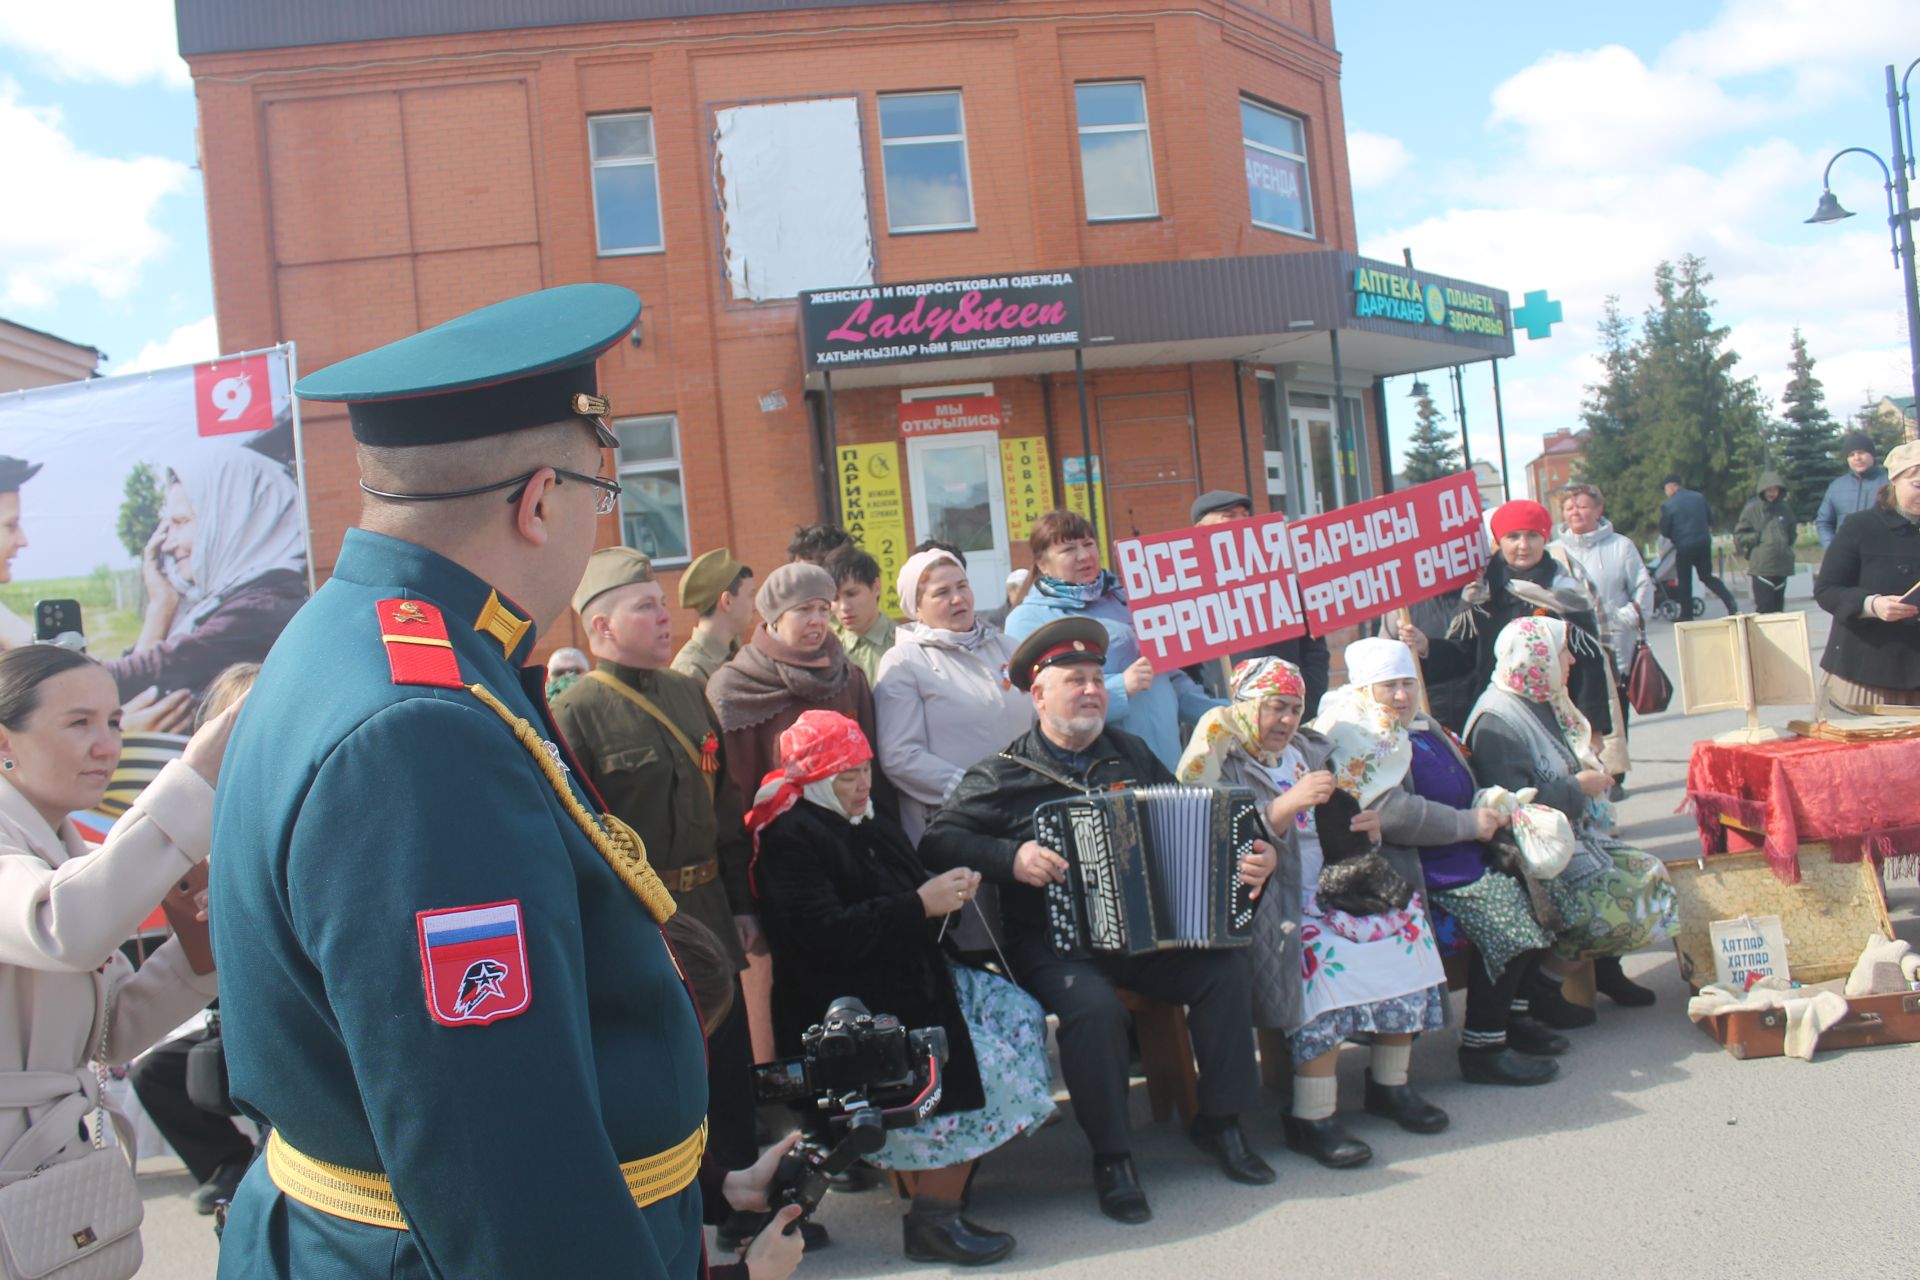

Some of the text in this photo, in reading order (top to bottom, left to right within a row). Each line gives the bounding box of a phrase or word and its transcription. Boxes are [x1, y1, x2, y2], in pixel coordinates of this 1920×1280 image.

[1246, 158, 1298, 198] АРЕНДА
[810, 273, 1073, 304] ЖЕНСКАЯ И ПОДРОСТКОВАЯ ОДЕЖДА
[1358, 268, 1423, 302] АПТЕКА
[1446, 288, 1495, 314] ПЛАНЕТА
[826, 291, 1067, 342] Lady&teen
[1449, 310, 1504, 336] ЗДОРОВЬЯ
[817, 345, 917, 363] ХАТЫН-КЫЗЛАР
[1038, 331, 1079, 345] КИЕМЕ
[212, 376, 252, 422] 9
[936, 404, 963, 416] МЫ
[902, 414, 1000, 433] ОТКРЫЛИСЬ
[1019, 441, 1038, 522] ТОВАРЫ
[882, 538, 894, 554] 2
[1290, 485, 1478, 573] БАРЫСЫ ДА
[1117, 521, 1293, 600] ВСЕ ДЛЯ
[883, 557, 900, 609] ЭТАЖ
[1303, 559, 1402, 622] ФРОНТ
[1132, 573, 1305, 657] ФРОНТА!
